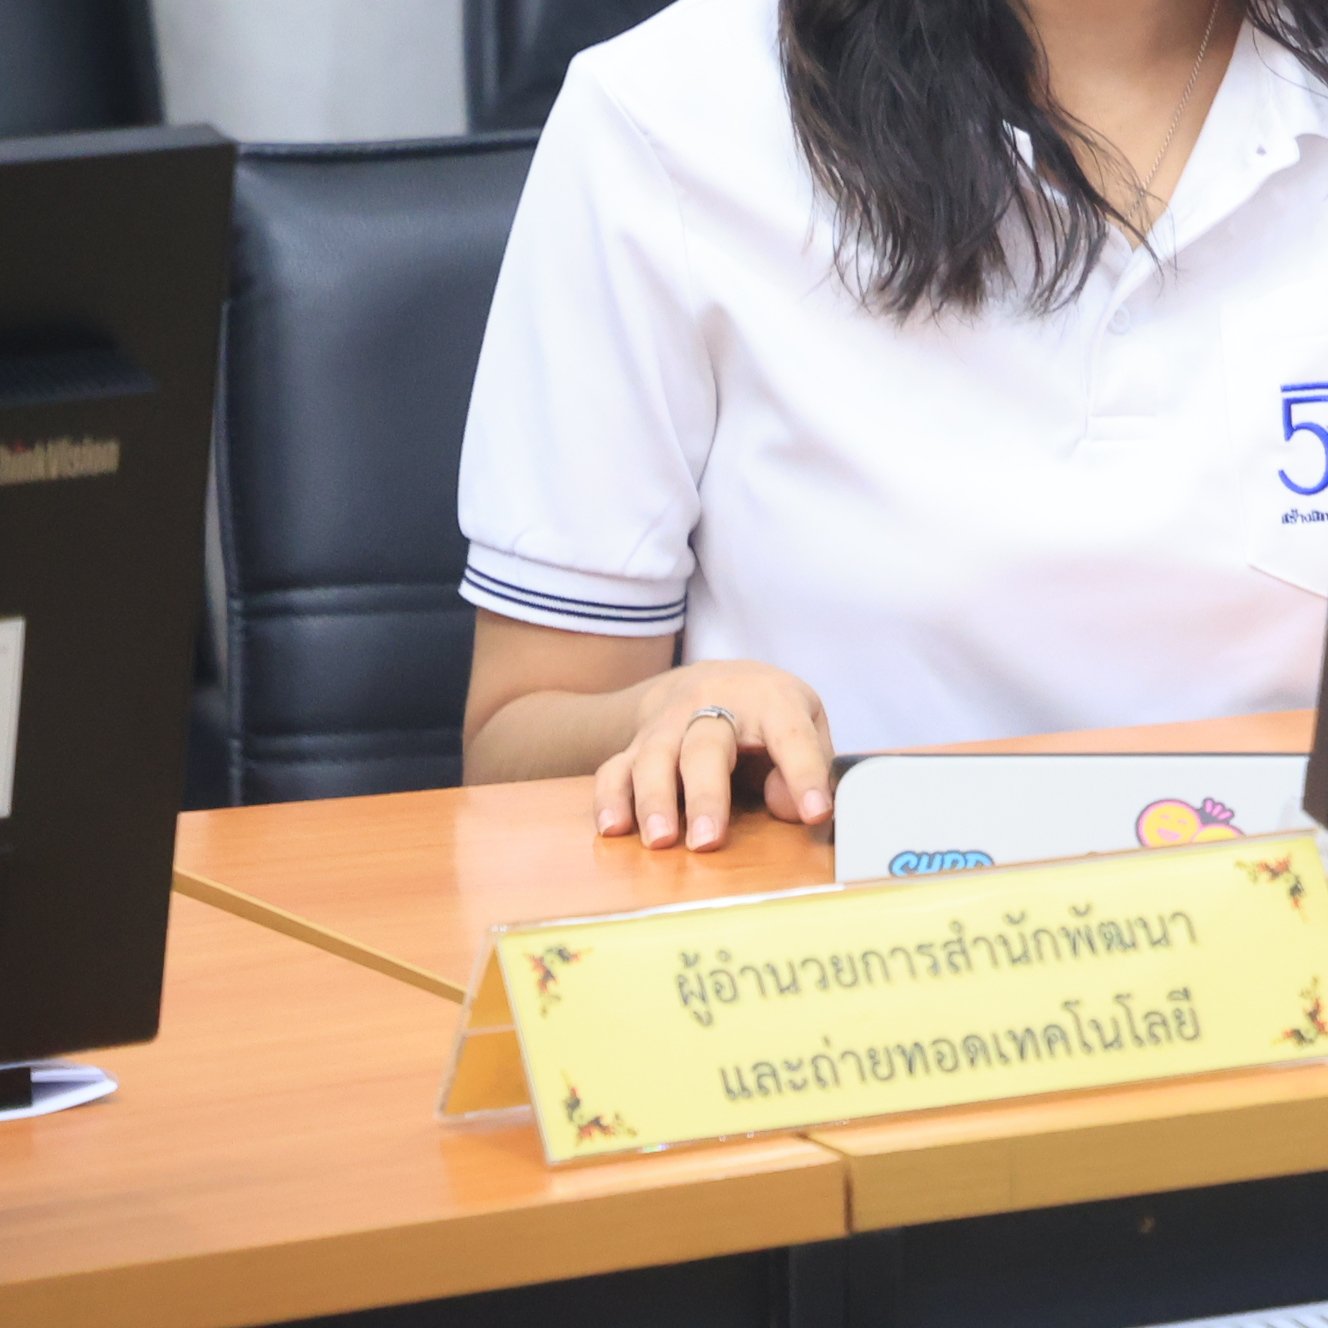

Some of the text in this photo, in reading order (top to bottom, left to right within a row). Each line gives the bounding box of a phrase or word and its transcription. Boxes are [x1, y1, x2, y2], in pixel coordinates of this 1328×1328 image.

[674, 904, 1198, 1028] ผู้อำนวยการสำนักพัฒนา
[718, 986, 1201, 1102] และถ่ายทอดเทคโนโลยี
